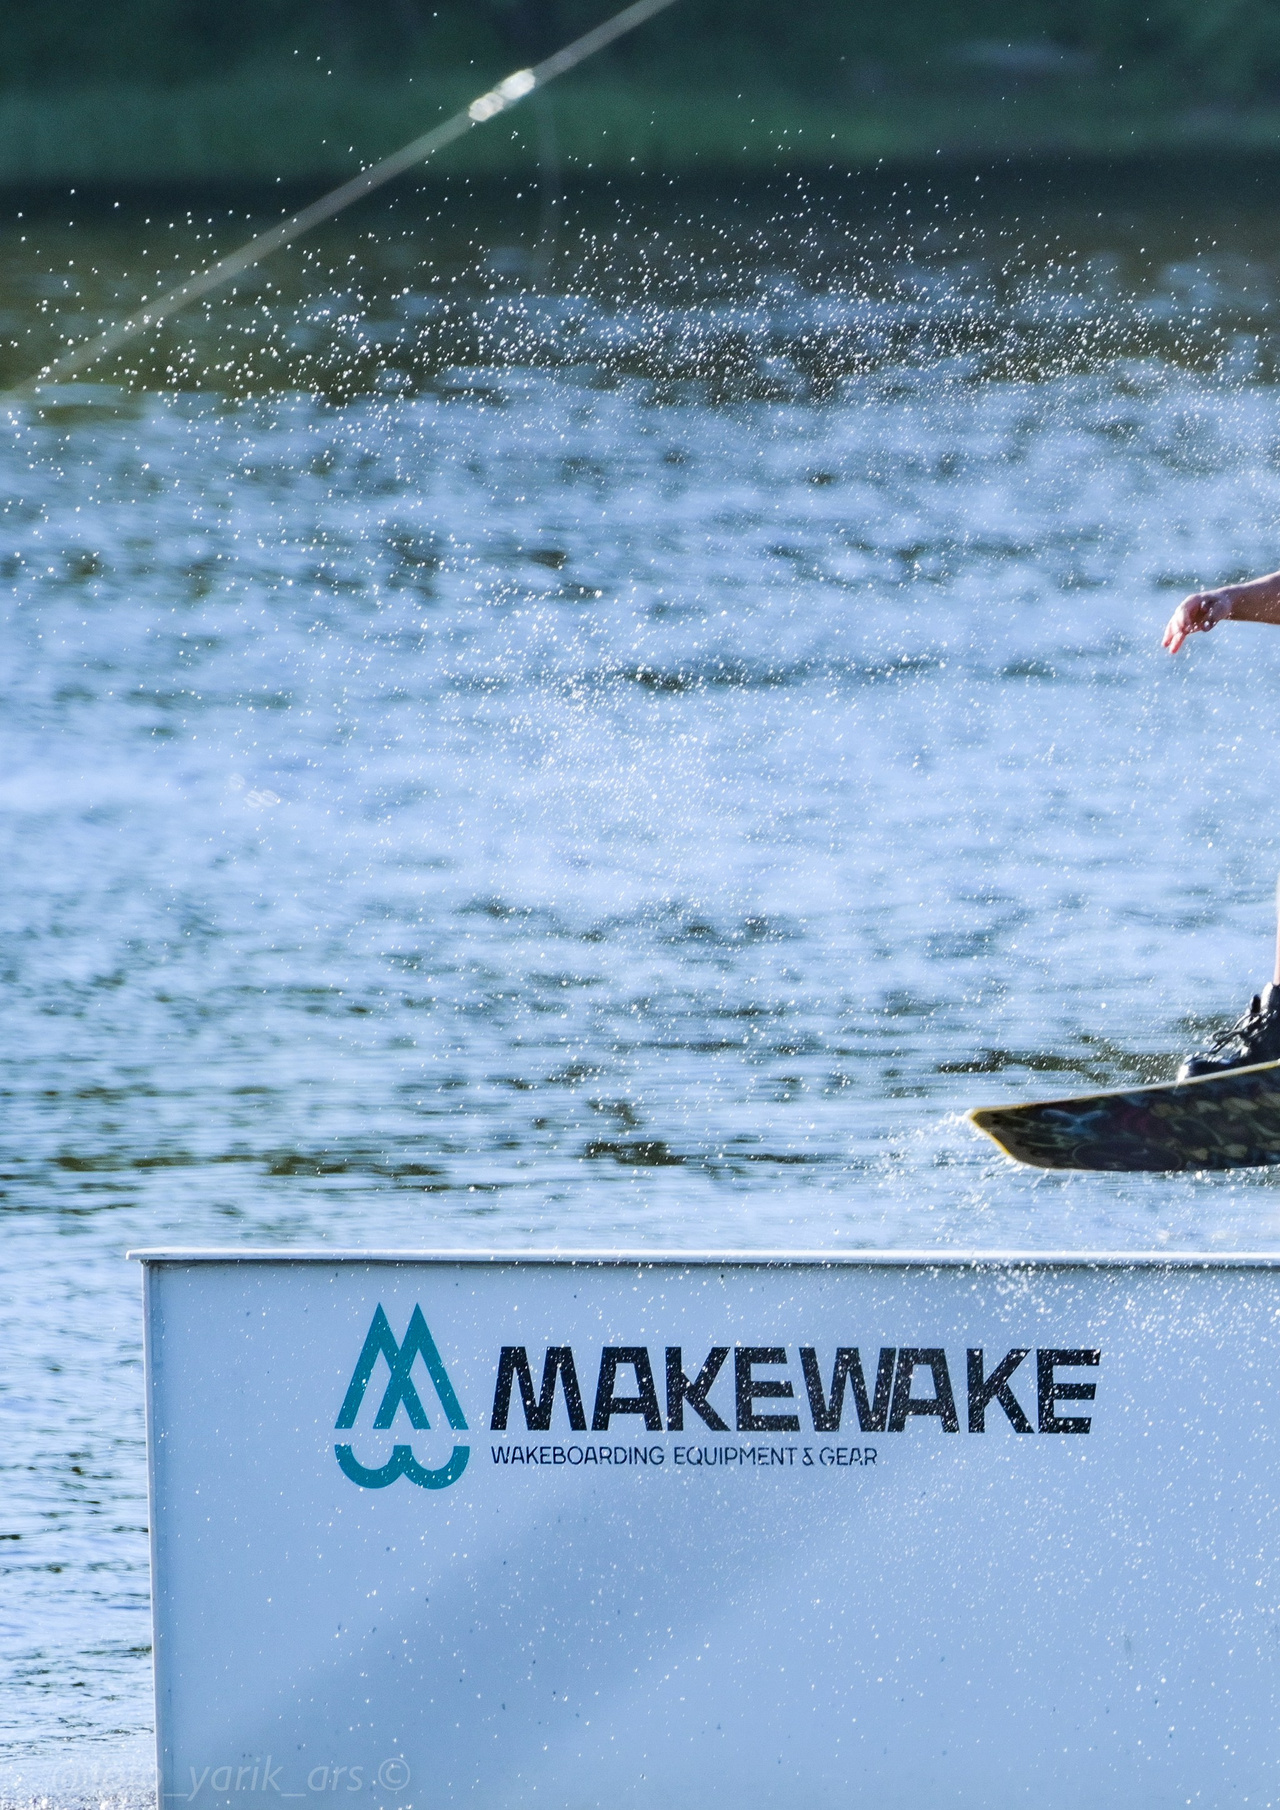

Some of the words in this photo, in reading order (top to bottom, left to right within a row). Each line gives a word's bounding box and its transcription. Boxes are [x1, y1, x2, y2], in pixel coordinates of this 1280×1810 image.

[489, 1346, 1102, 1435] MAKEWAKE
[491, 1446, 665, 1466] WAKEBOARDING
[674, 1446, 798, 1466] EQUIPMENT
[802, 1447, 814, 1466] &
[819, 1447, 878, 1467] GEAR
